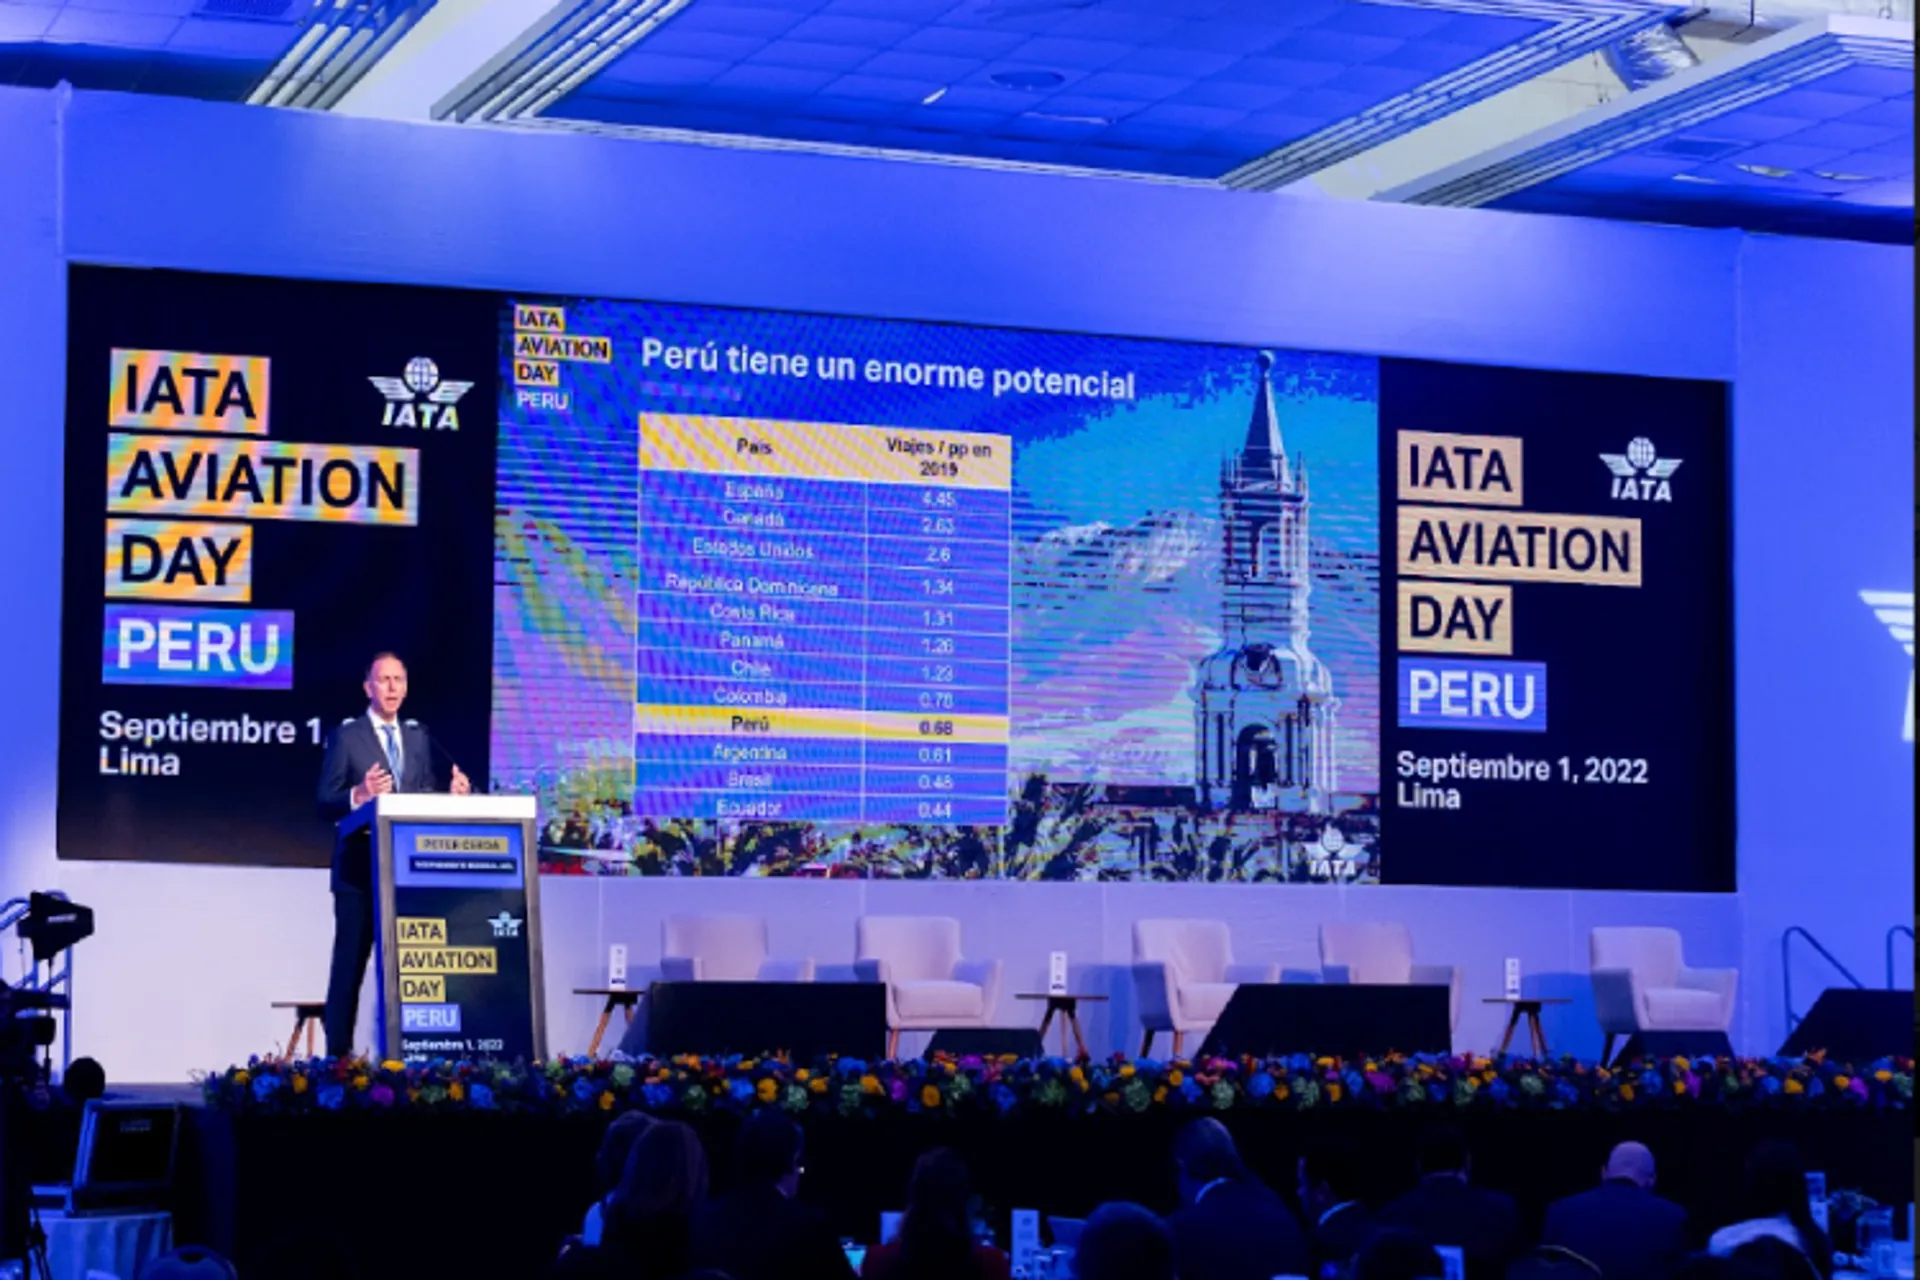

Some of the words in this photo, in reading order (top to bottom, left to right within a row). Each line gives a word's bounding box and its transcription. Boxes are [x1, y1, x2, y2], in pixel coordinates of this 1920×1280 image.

[520, 310, 560, 327] IATA
[519, 336, 608, 358] AVIATION
[518, 363, 555, 380] DAY
[642, 337, 718, 370] Perú
[725, 344, 808, 378] tiene
[817, 355, 855, 380] un
[864, 359, 984, 389] enorme
[993, 366, 1134, 400] potencial
[126, 363, 256, 419] IATA
[517, 389, 569, 410] PERU
[382, 402, 459, 430] IATA
[886, 437, 935, 456] Viajes
[948, 443, 969, 459] pp
[972, 444, 992, 457] en
[920, 461, 959, 477] 2019
[1409, 444, 1513, 493] IATA
[120, 449, 405, 510] AVIATION
[1611, 477, 1672, 502] IATA
[922, 491, 955, 507] 4.45
[693, 537, 755, 557] Estados
[759, 541, 815, 558] Unidos
[926, 545, 951, 562] 2.6
[1409, 519, 1630, 573] AVIATION
[121, 533, 241, 587] DAY
[709, 603, 755, 620] Costa
[759, 604, 795, 621] Rica
[923, 610, 953, 626] 1.31
[1410, 595, 1504, 641] DAY
[118, 618, 280, 675] PERU
[731, 660, 771, 677] Chile
[1409, 669, 1535, 719] PERU
[99, 710, 296, 747] Septiembre
[731, 715, 770, 732] Perú
[919, 720, 953, 736] 0.68
[99, 746, 181, 776] Lima
[1397, 751, 1550, 783] Septiembre
[1558, 757, 1579, 785] 1,
[1585, 758, 1649, 784] 2022
[1397, 782, 1461, 810] Lima
[1309, 860, 1356, 877] IATA
[401, 921, 443, 939] IATA
[401, 951, 493, 968] AVIATION
[403, 979, 441, 997] DAY
[404, 1008, 457, 1028] PERU
